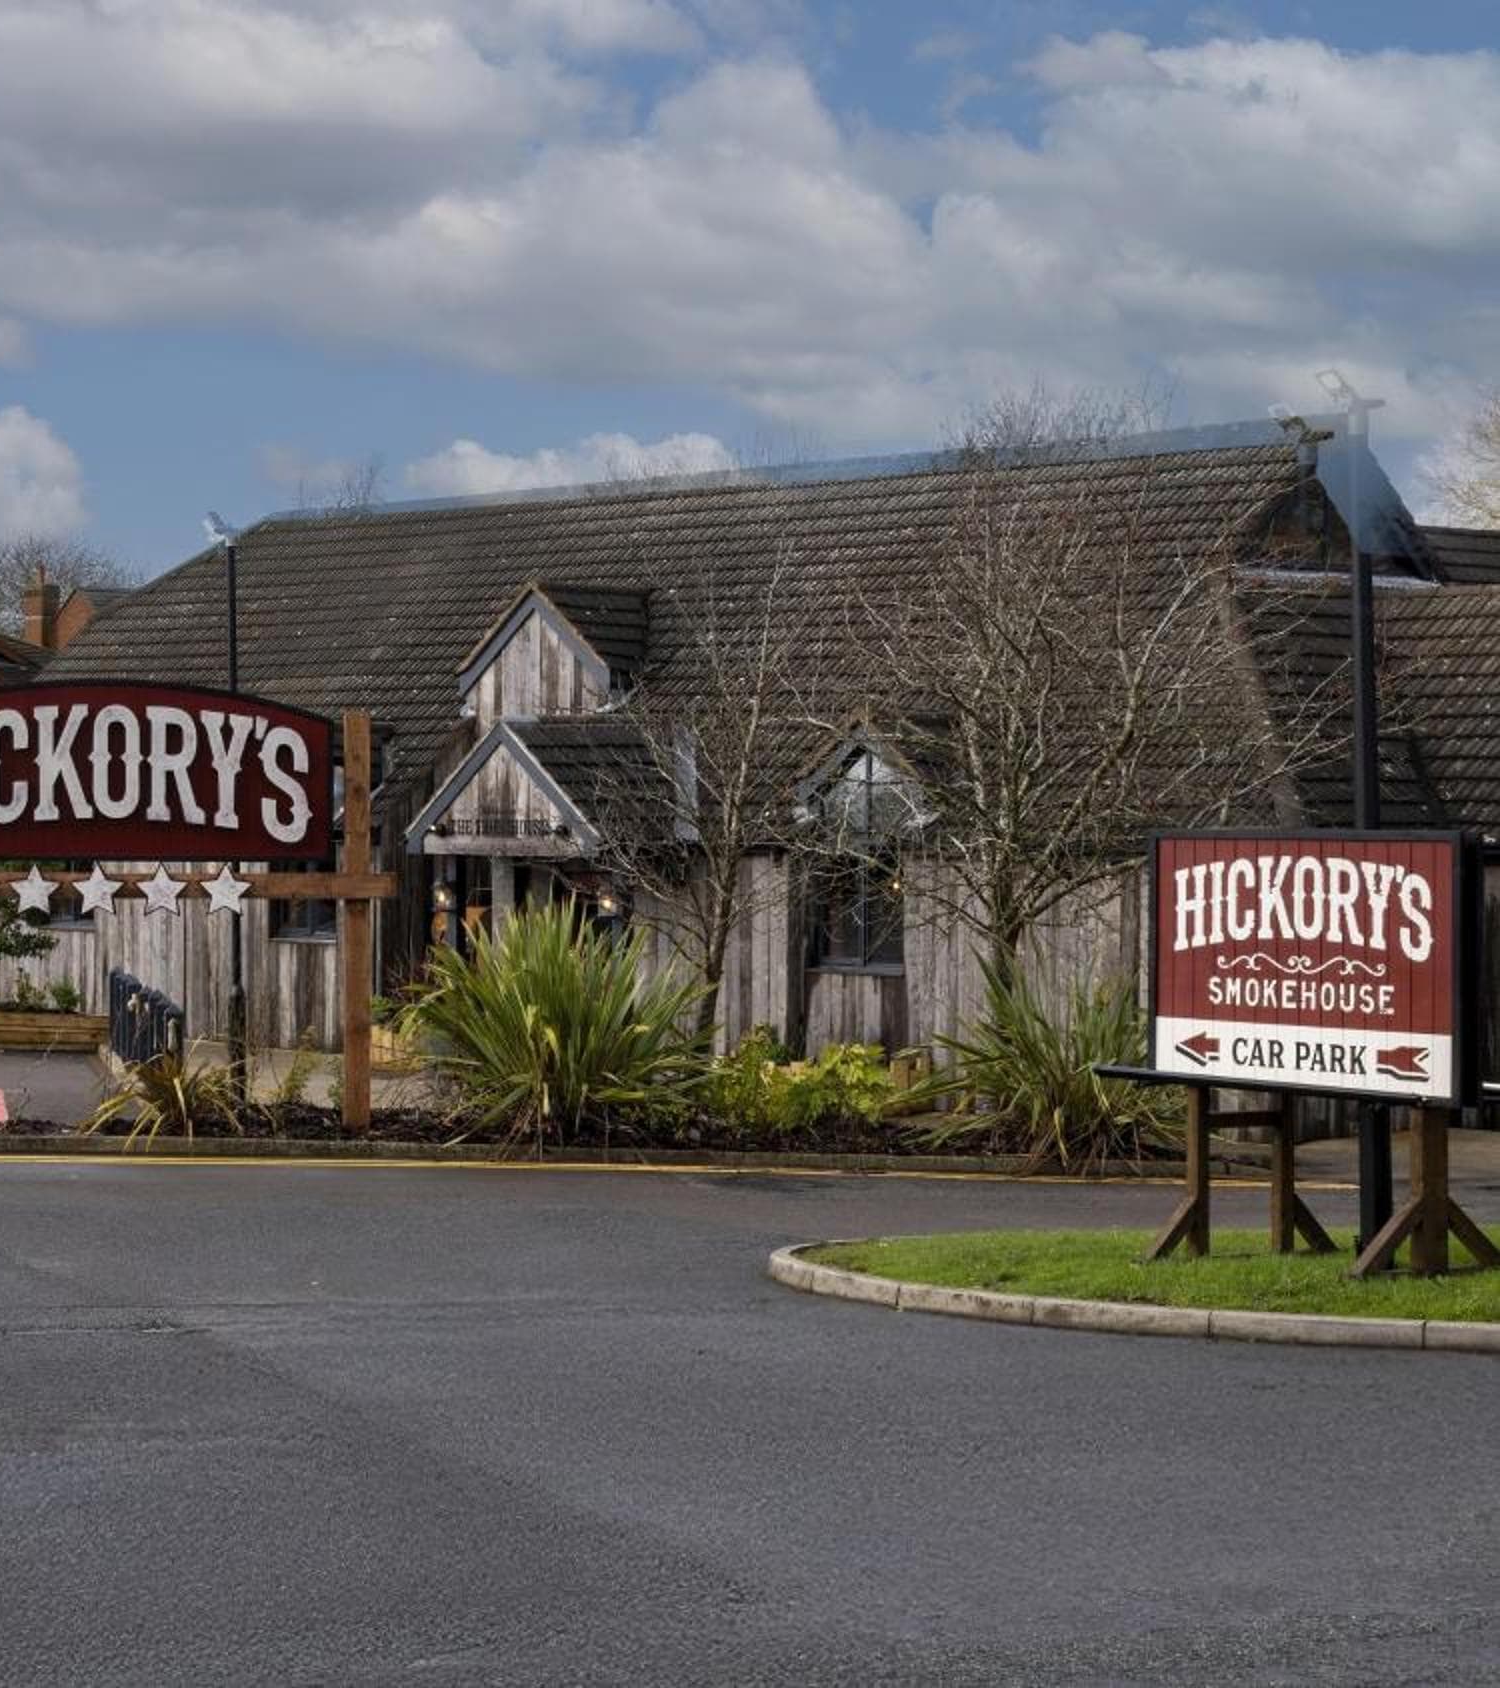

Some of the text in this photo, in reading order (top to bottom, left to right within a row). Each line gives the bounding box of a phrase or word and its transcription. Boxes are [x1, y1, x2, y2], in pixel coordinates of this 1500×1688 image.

[1173, 855, 1434, 963] HICKORY'S
[1207, 976, 1395, 1015] SMOKEHOUSE
[1232, 1037, 1367, 1075] CAR PARK
